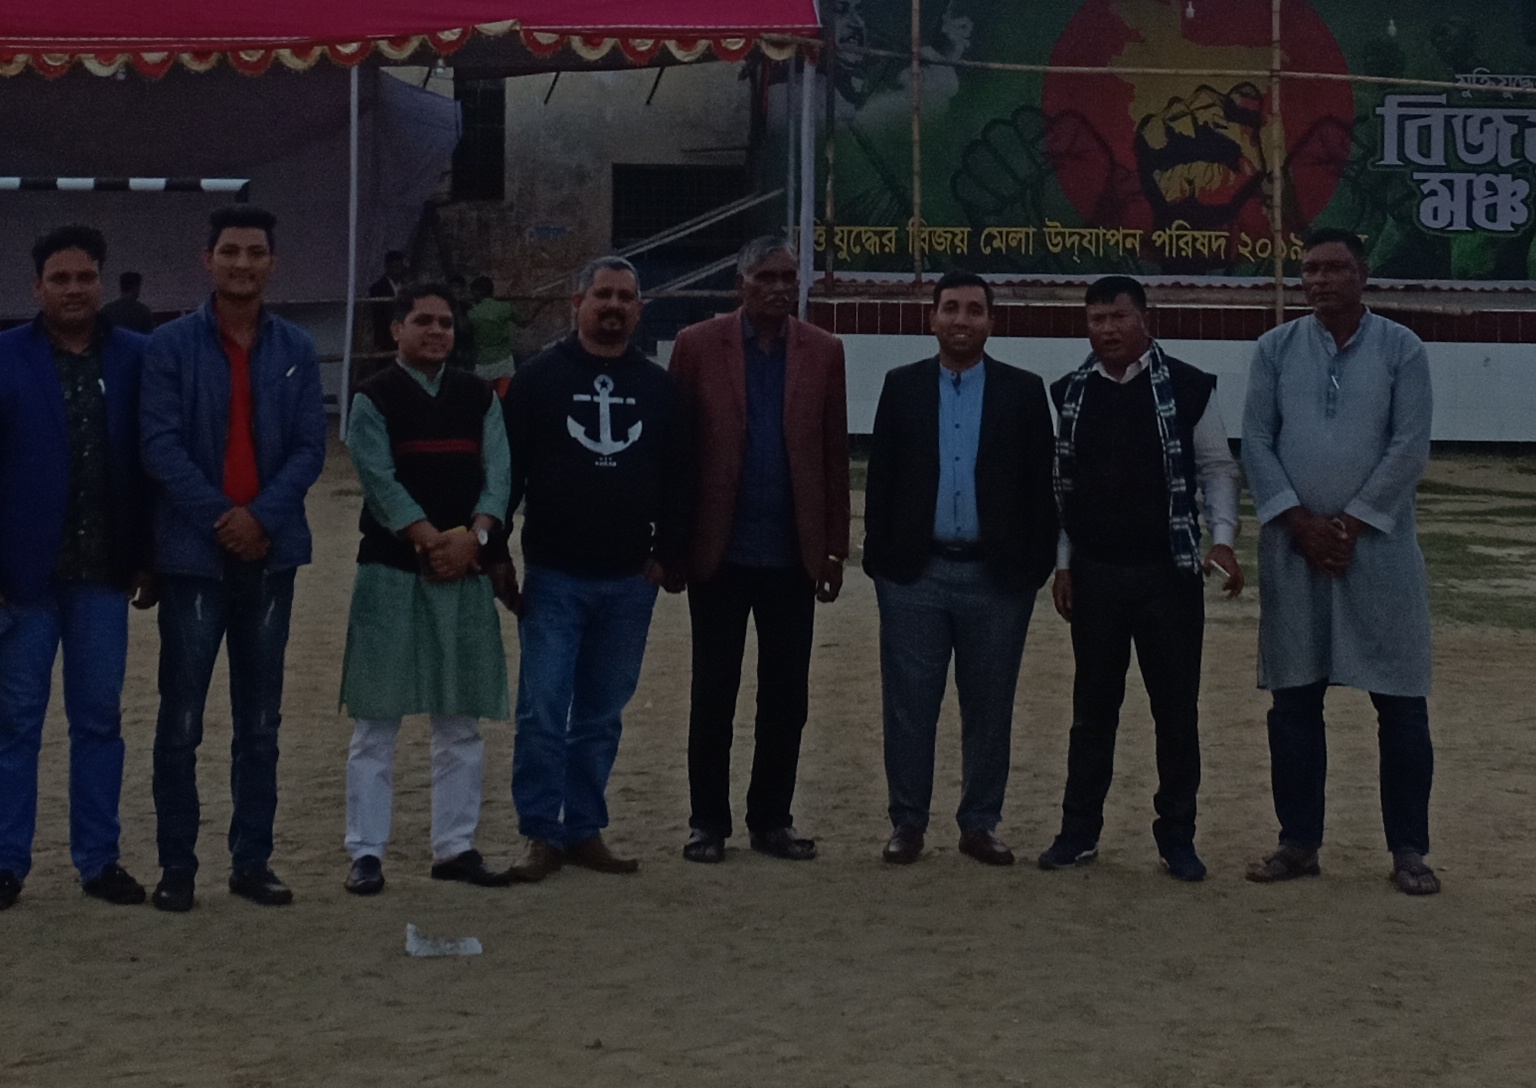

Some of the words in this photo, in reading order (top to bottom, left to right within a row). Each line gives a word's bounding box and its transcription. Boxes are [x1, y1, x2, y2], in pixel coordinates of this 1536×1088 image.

[1412, 171, 1531, 232] মঞ্চ
[905, 216, 973, 256] বিজয়
[979, 224, 1038, 257] মেলা
[1151, 219, 1231, 261] পরিষদ
